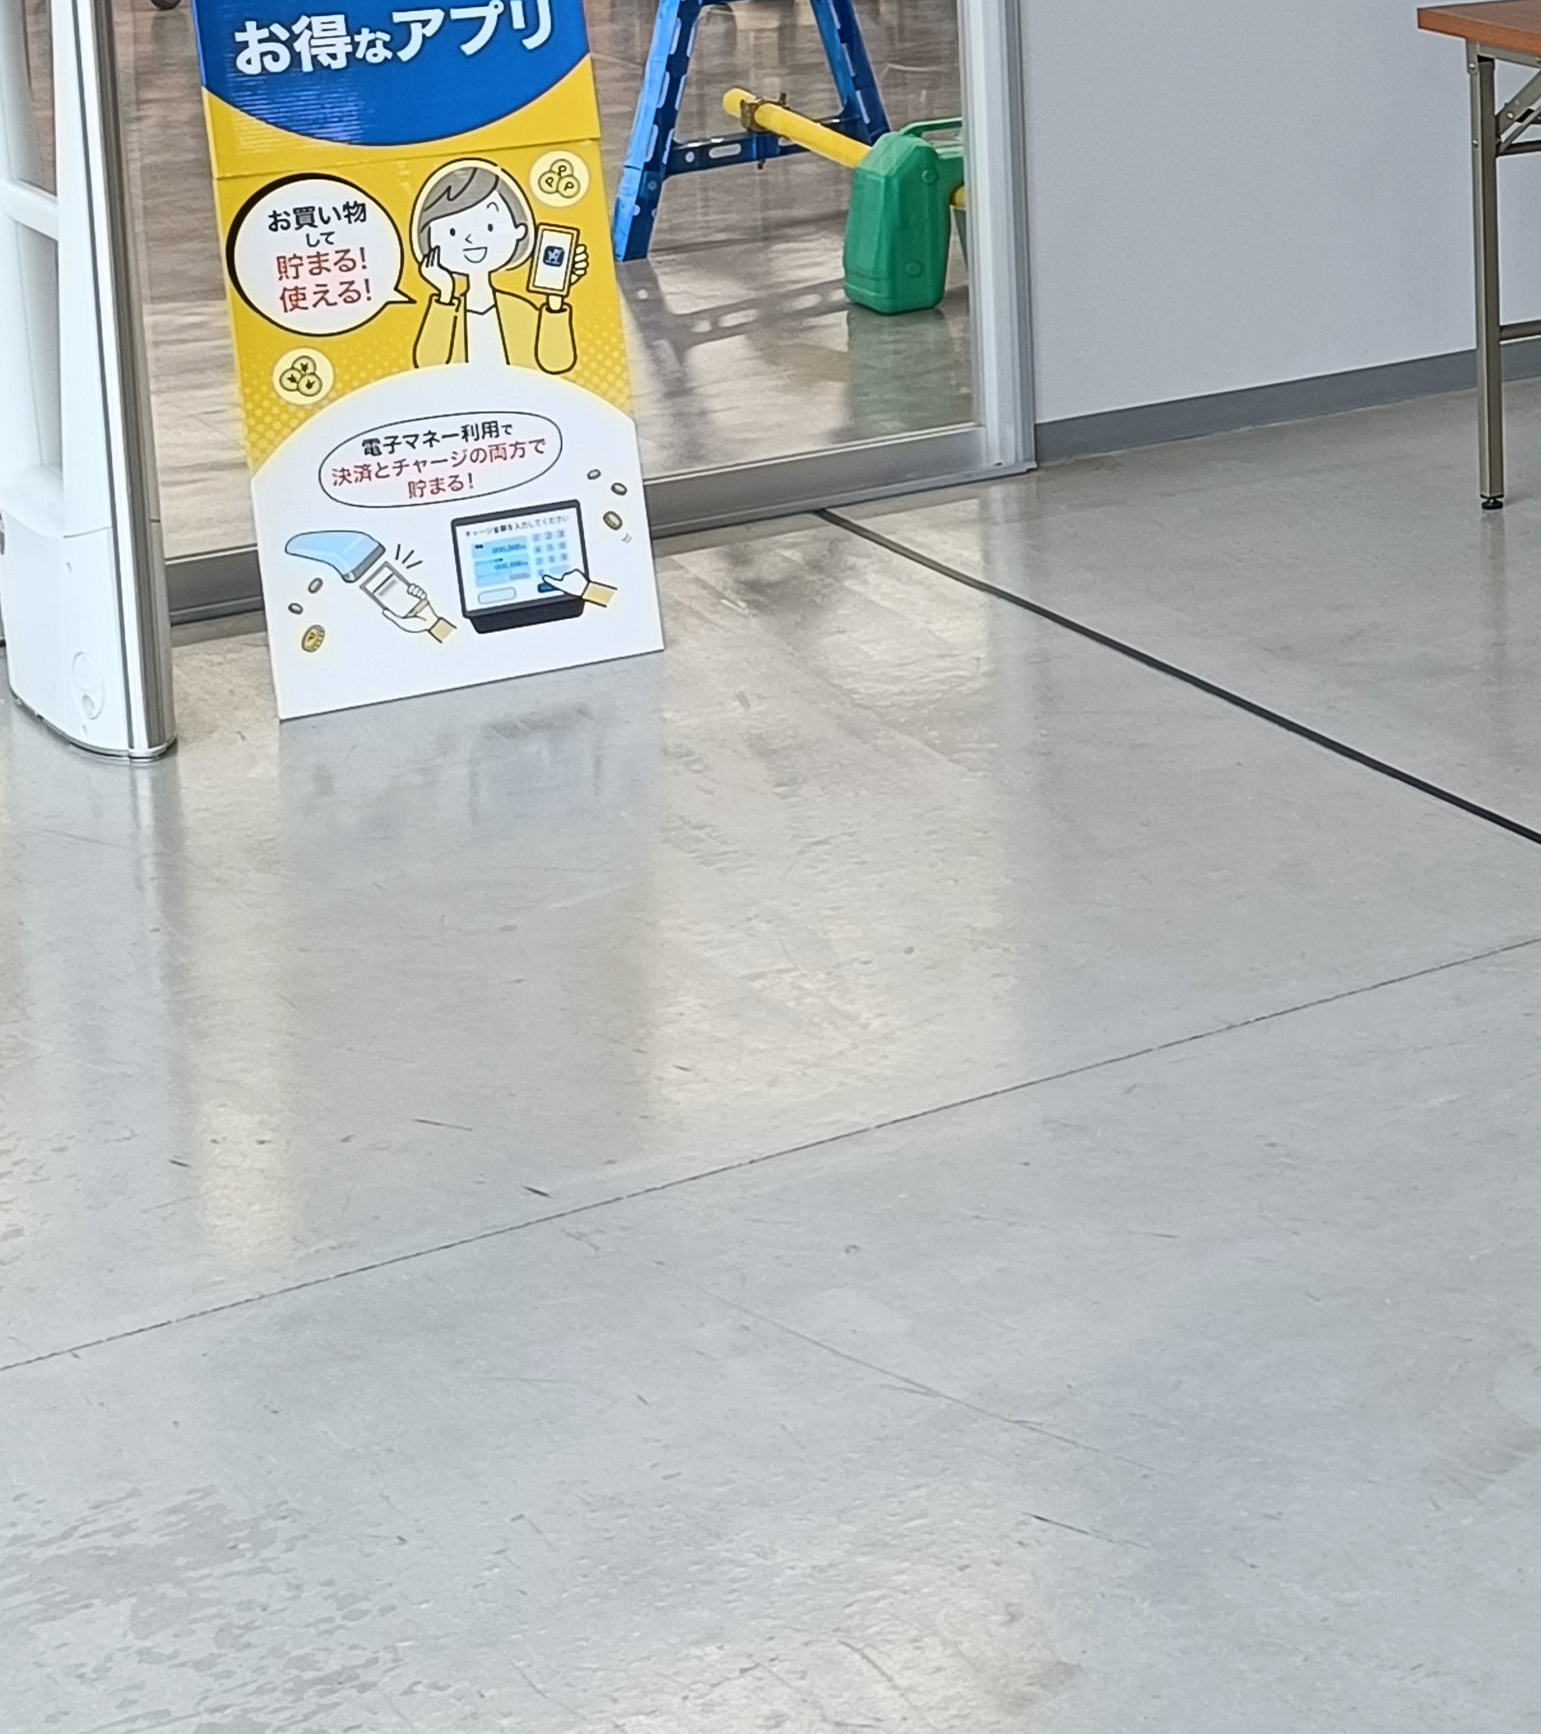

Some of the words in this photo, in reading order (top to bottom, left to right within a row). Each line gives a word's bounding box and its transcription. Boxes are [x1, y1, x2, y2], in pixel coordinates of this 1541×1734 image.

[267, 200, 367, 232] お買い物
[305, 231, 336, 248] して
[276, 246, 368, 281] 貯まる!
[279, 278, 373, 313] 使える!
[361, 420, 514, 457] 電子マネー利用で
[332, 438, 547, 487] 決済とチャージの両方で
[407, 472, 475, 499] 貯まる!
